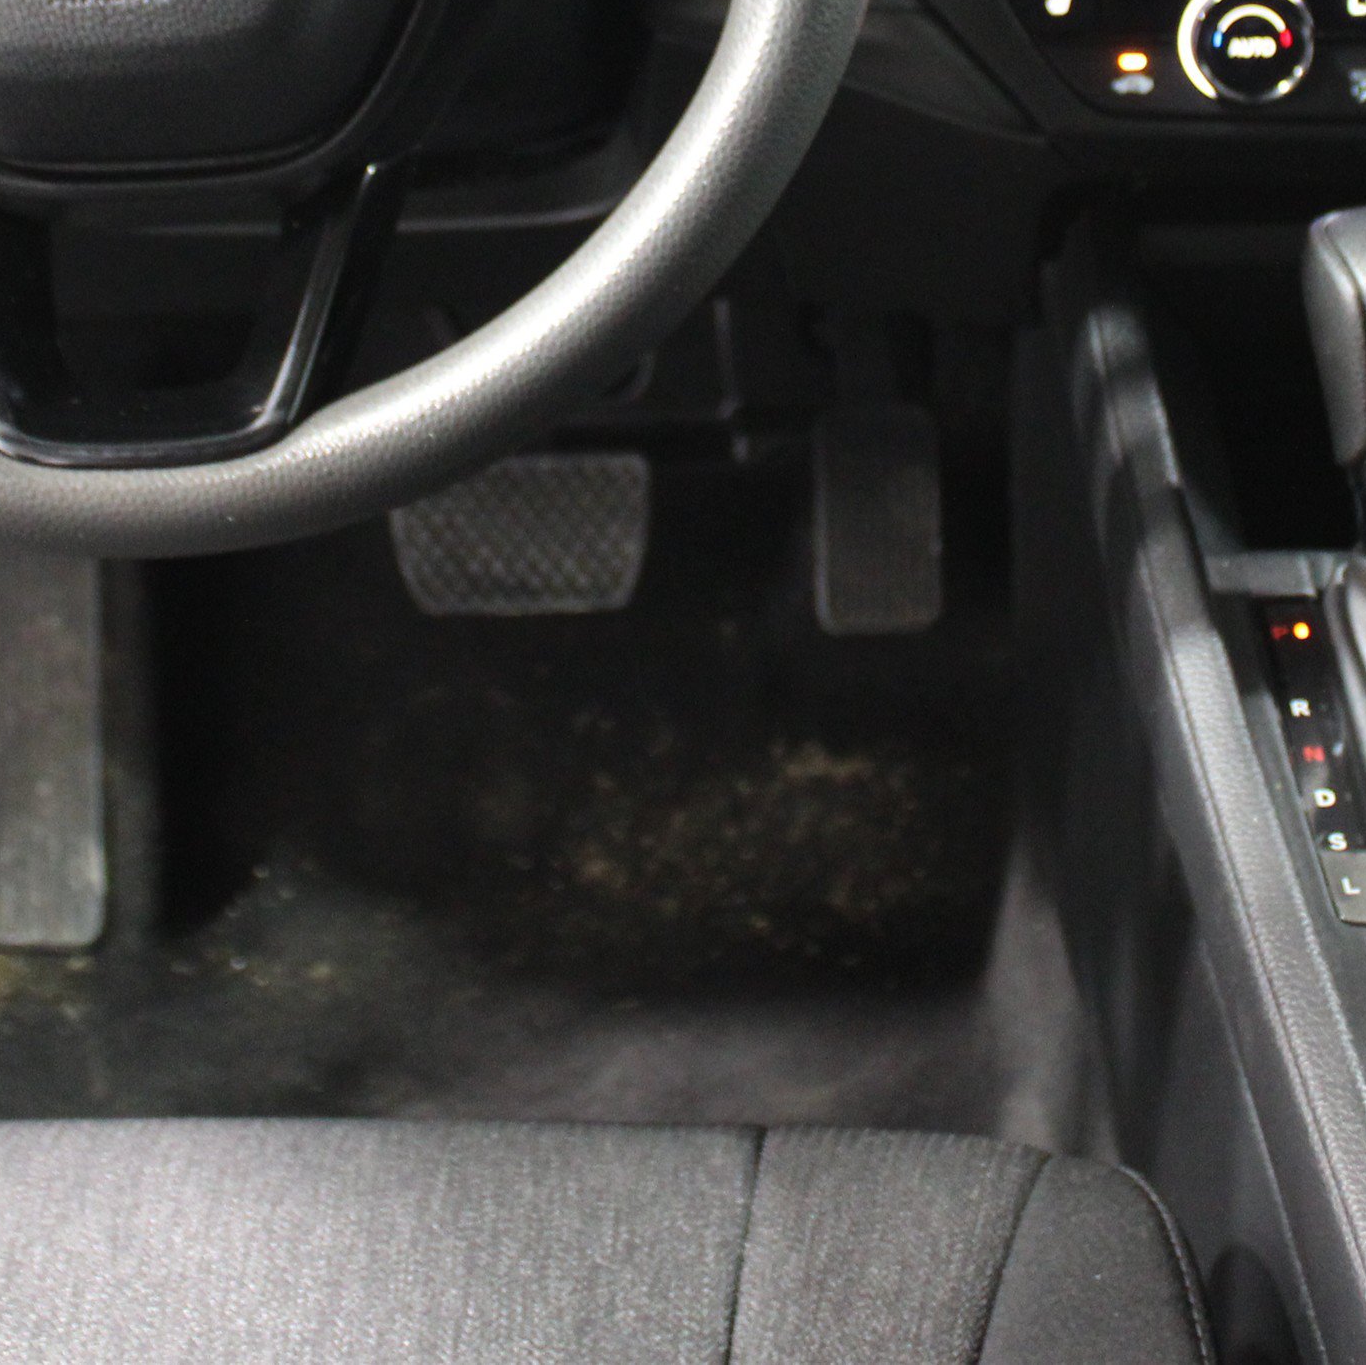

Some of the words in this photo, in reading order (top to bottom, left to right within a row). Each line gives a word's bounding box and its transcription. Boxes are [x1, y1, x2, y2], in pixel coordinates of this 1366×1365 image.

[1290, 698, 1311, 717] R
[1314, 788, 1336, 808] D
[1328, 832, 1348, 851] S
[1341, 878, 1361, 895] L
